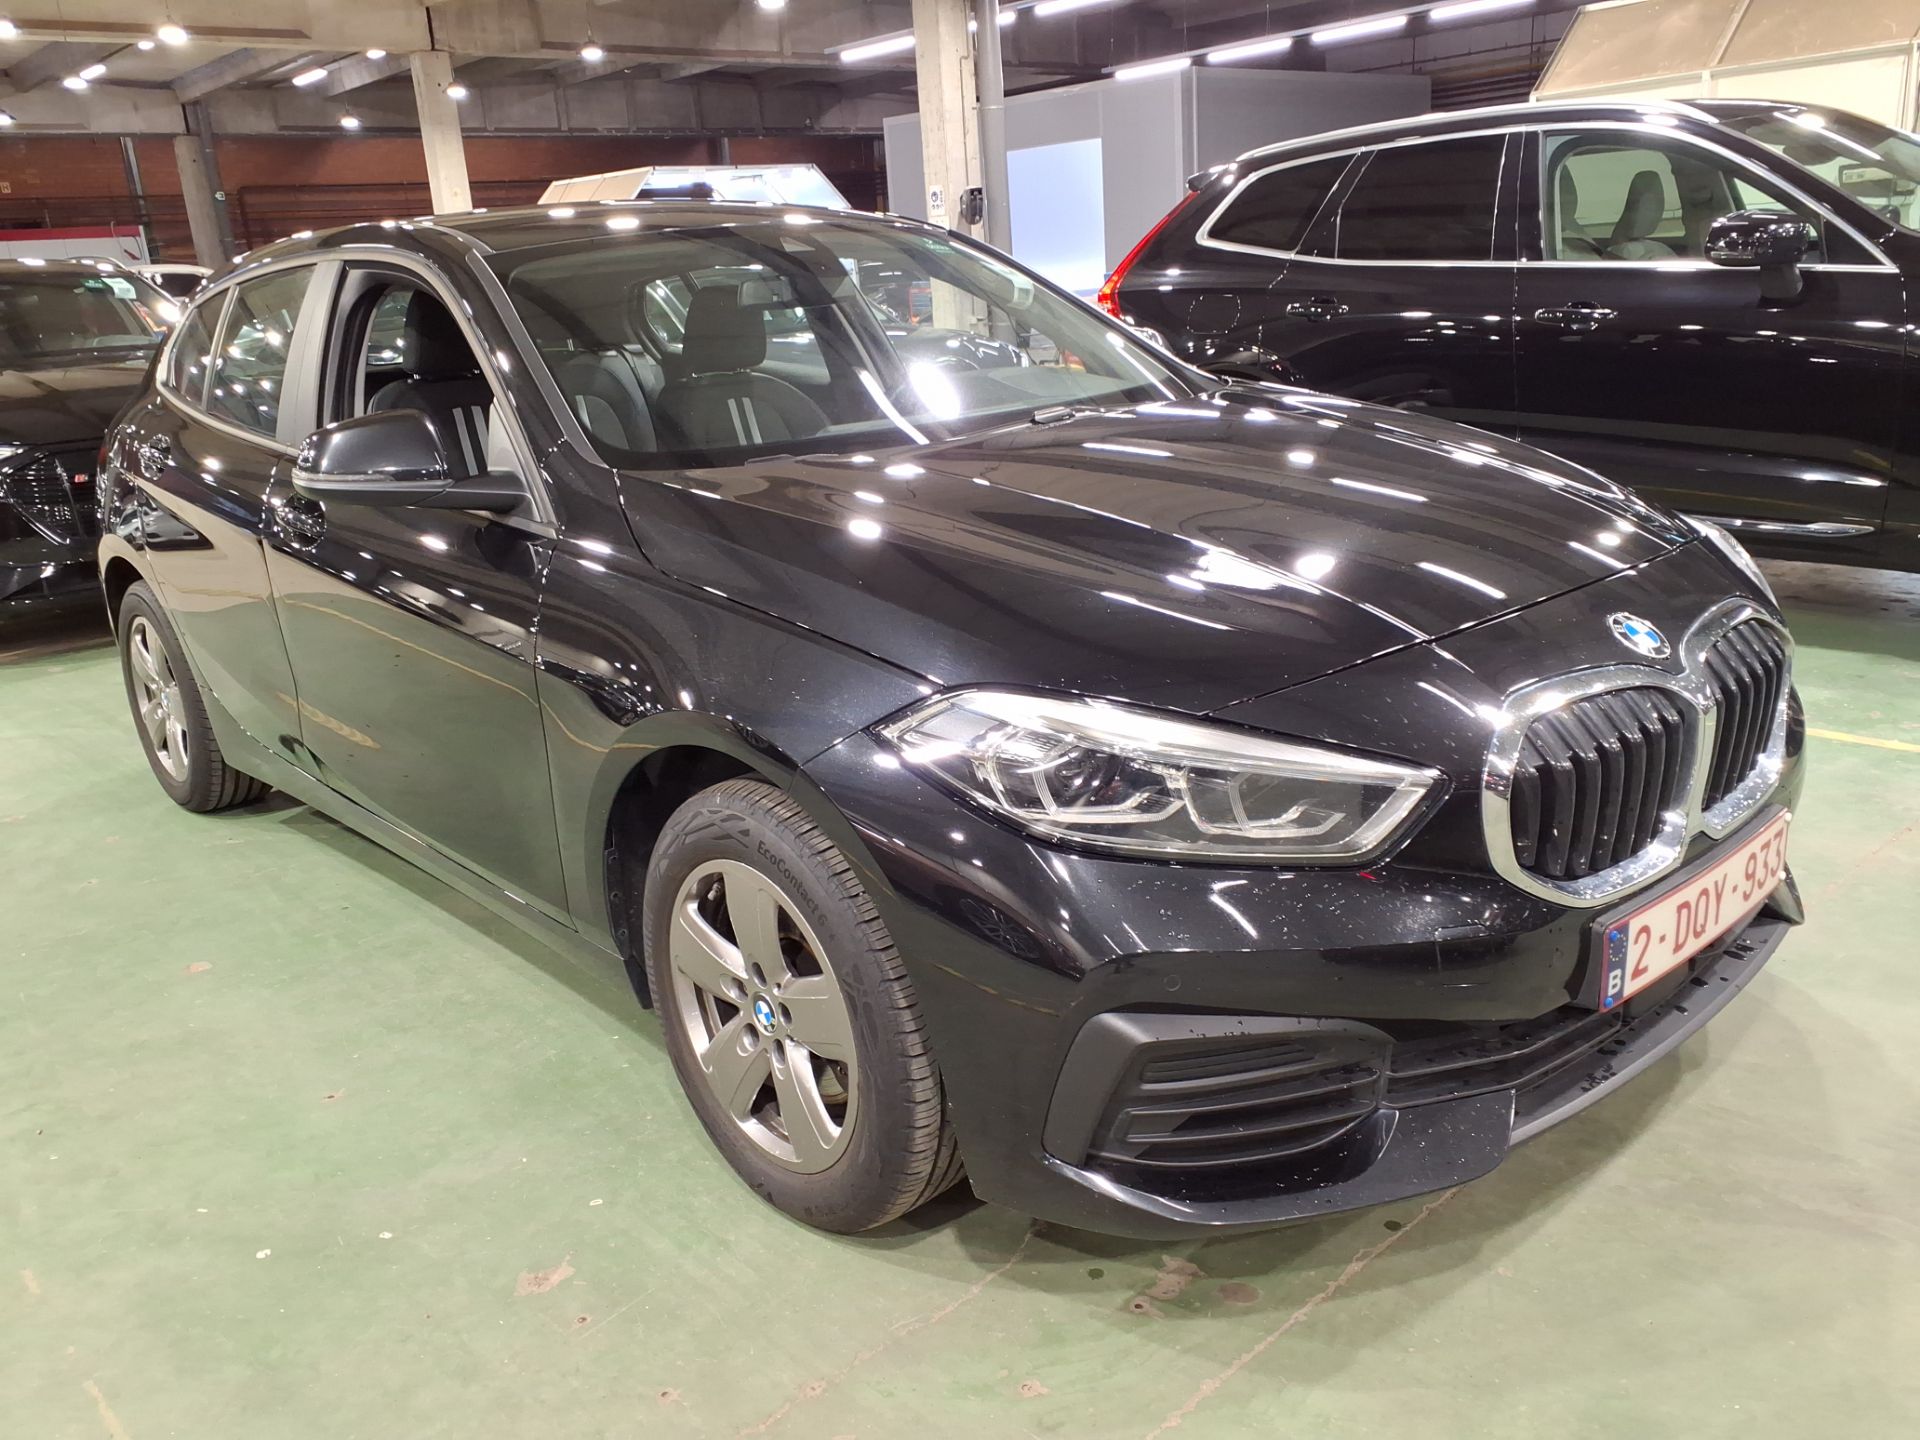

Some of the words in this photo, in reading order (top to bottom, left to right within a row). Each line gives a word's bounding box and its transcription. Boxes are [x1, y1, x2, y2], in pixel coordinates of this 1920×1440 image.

[757, 839, 820, 915] EcoContact
[1630, 827, 1784, 982] 2-DQY-933
[1608, 969, 1622, 996] B
